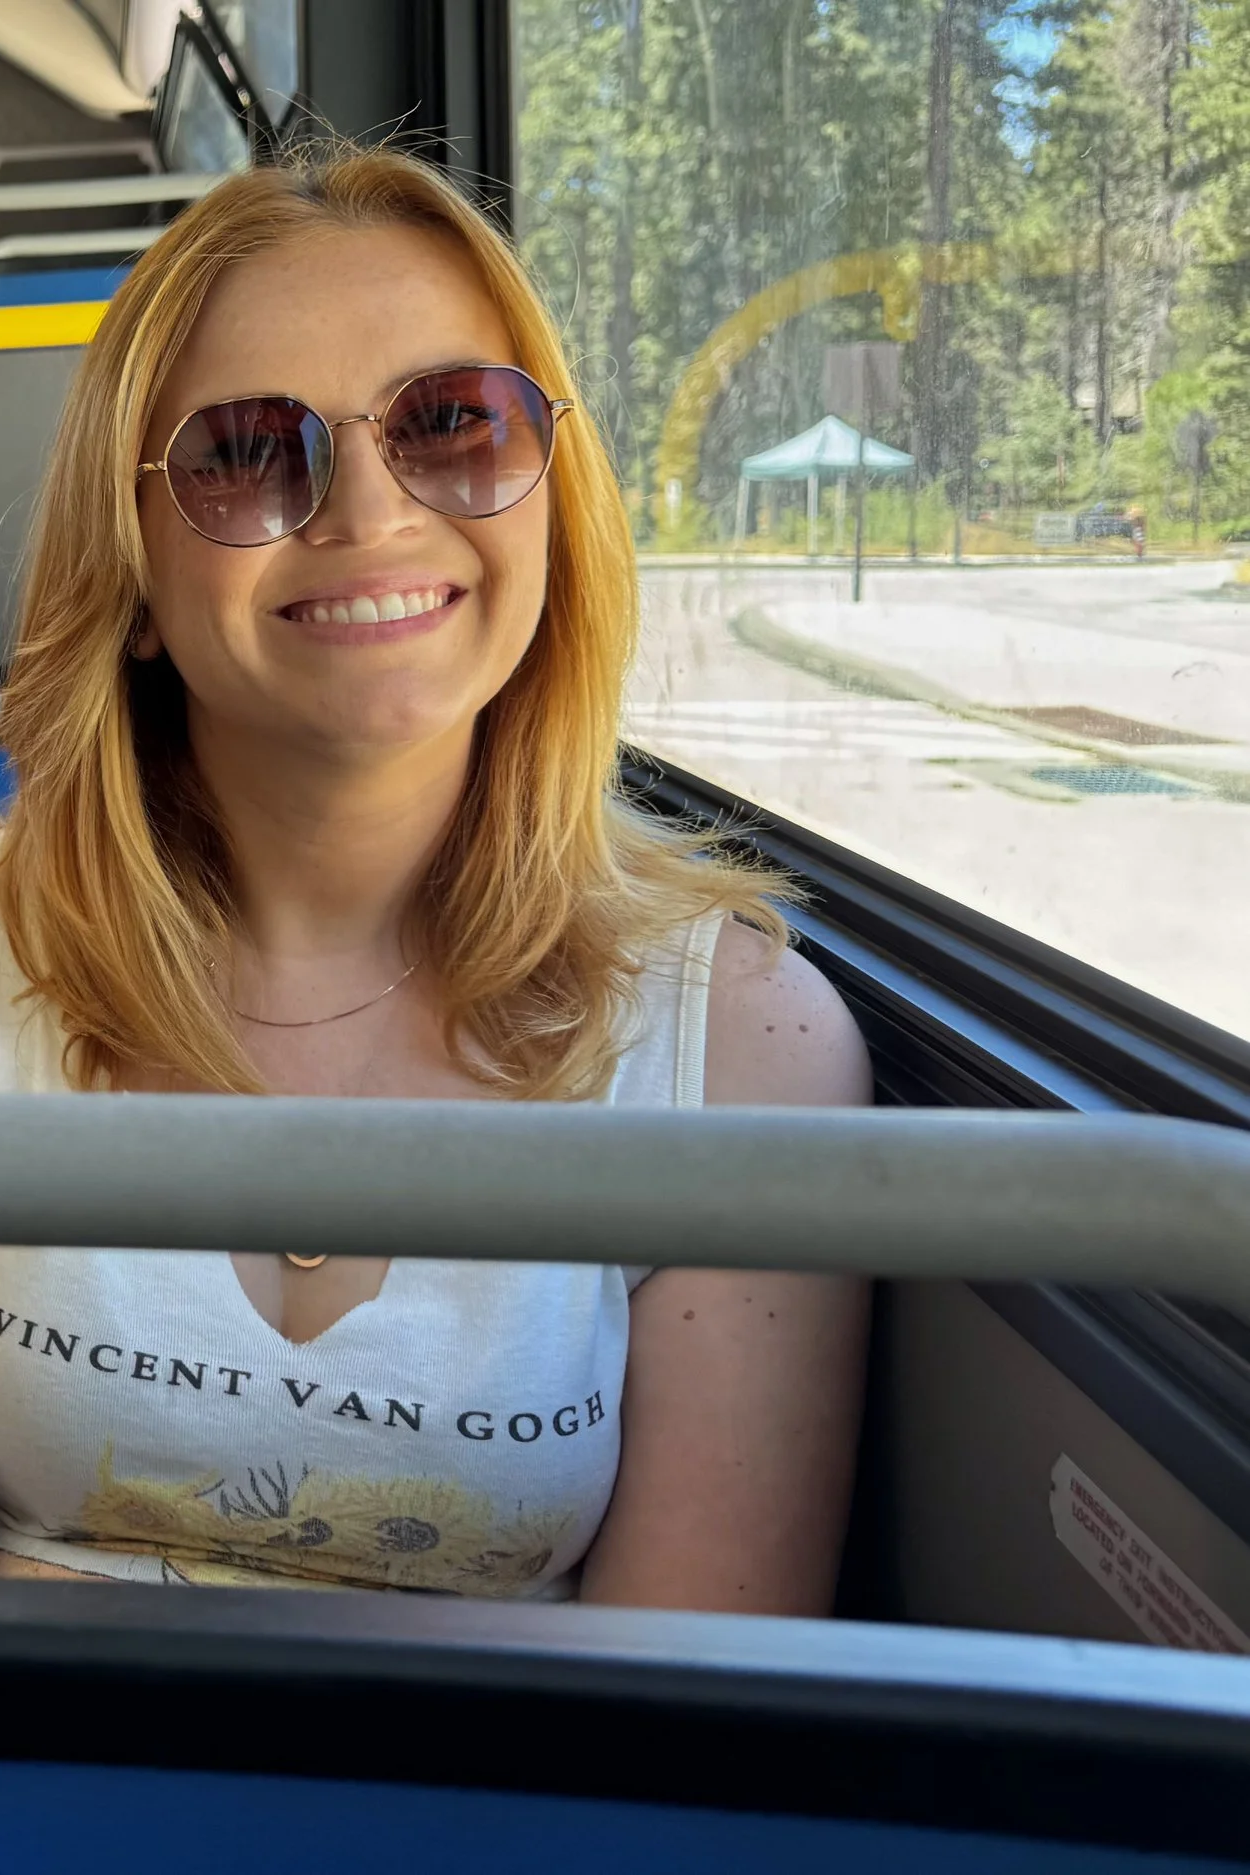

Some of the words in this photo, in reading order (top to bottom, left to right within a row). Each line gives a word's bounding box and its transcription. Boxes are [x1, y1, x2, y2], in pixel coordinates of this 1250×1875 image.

[281, 1376, 425, 1432] VAN
[456, 1390, 605, 1443] GOGH
[1070, 1477, 1127, 1541] EMERGENCY
[1071, 1501, 1114, 1554] LOCATED
